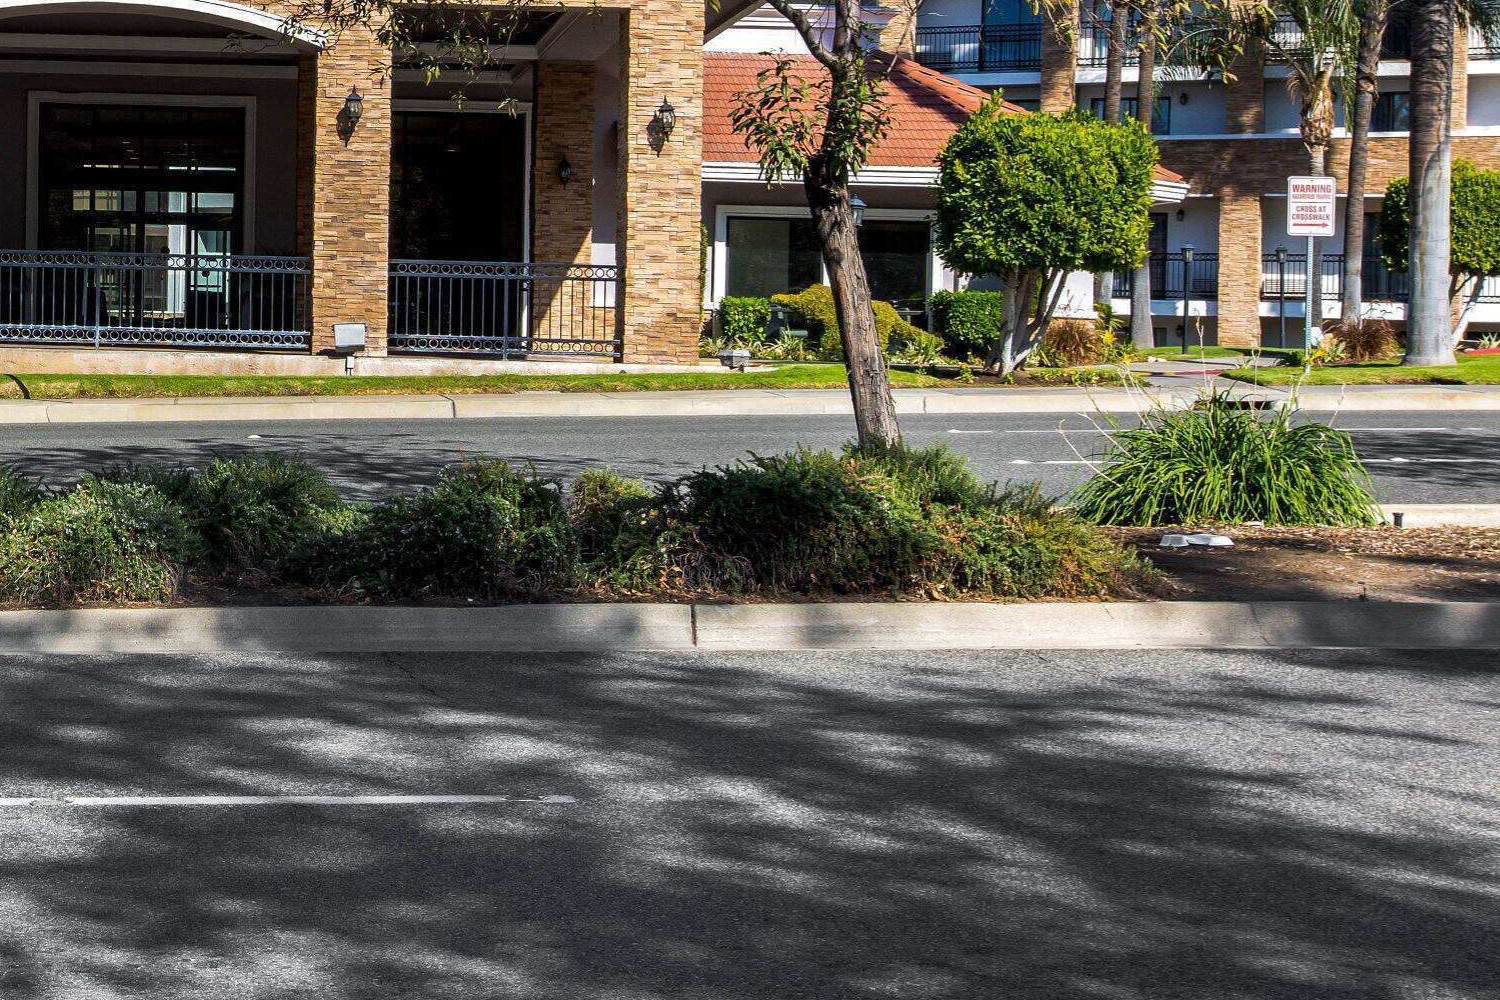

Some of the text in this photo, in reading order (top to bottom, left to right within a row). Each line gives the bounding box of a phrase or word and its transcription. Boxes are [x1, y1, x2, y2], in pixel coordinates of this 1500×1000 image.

[1292, 184, 1331, 193] WARNING
[1296, 205, 1327, 213] CROSS AT
[1292, 213, 1330, 221] CROSSWALK
